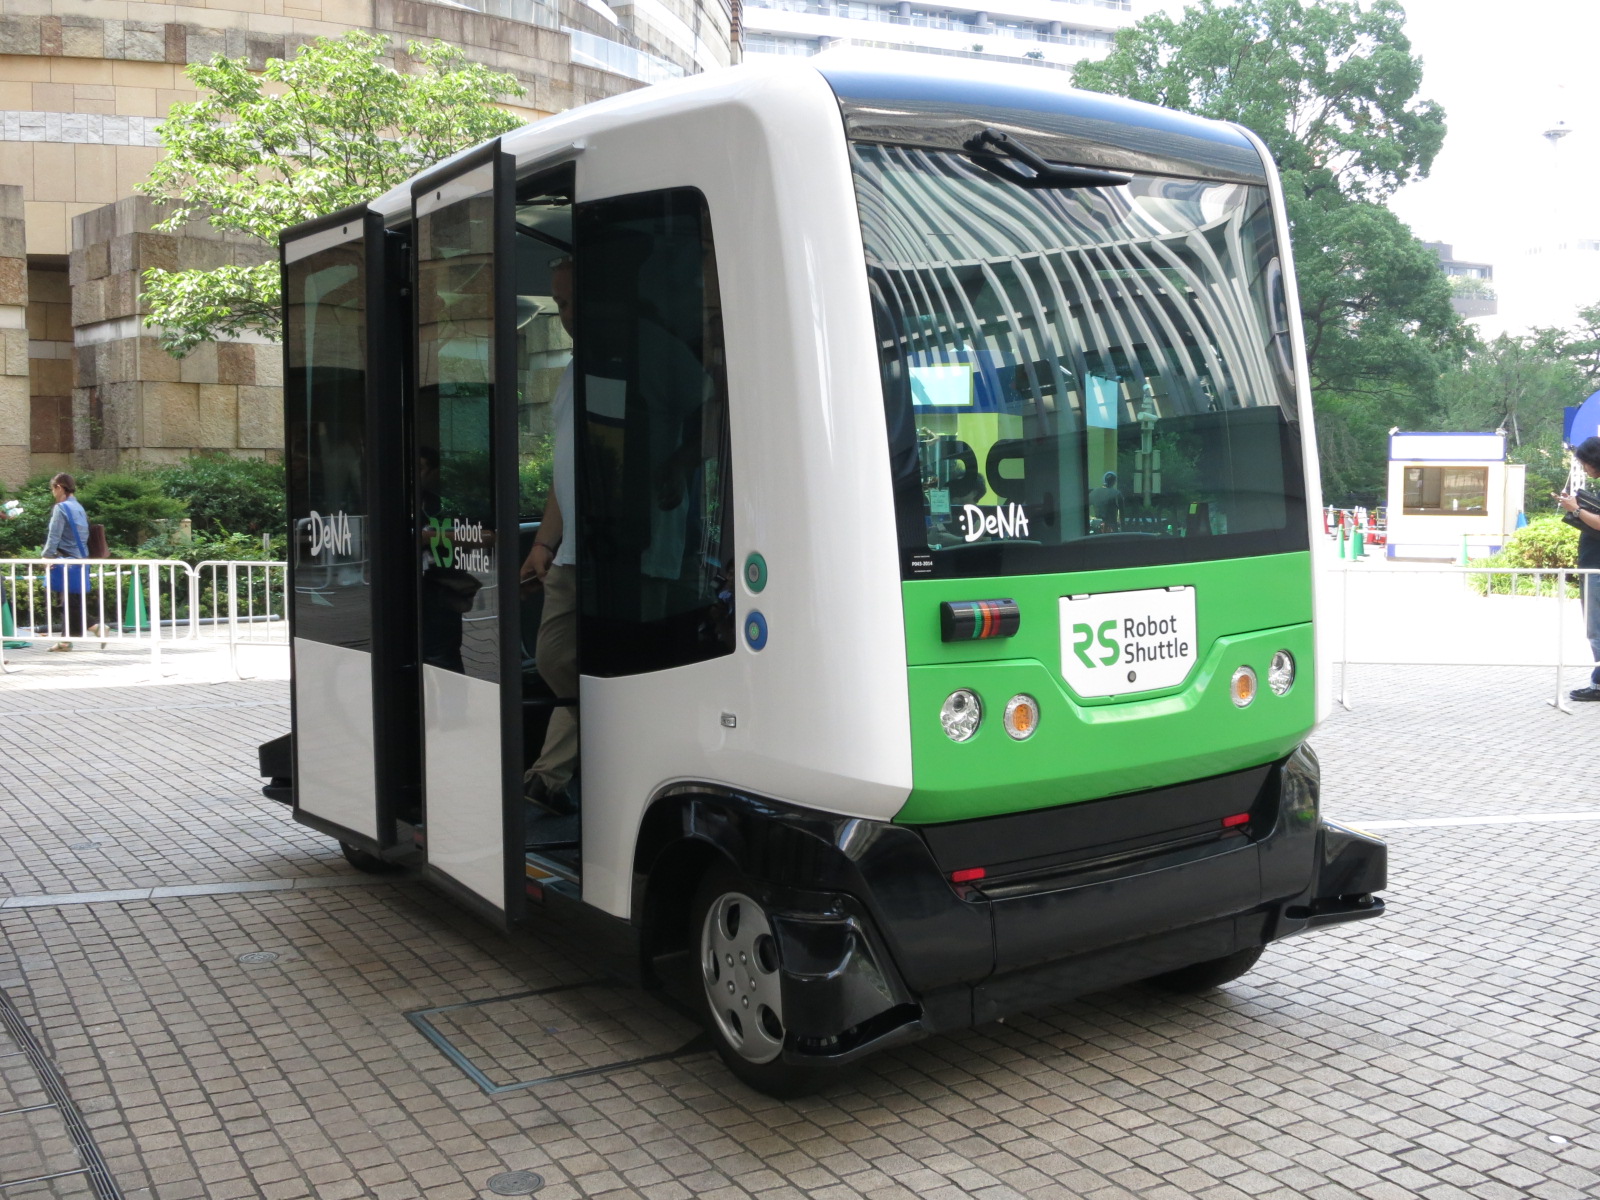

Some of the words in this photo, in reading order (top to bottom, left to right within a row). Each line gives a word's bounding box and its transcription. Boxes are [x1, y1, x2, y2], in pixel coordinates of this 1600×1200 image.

[430, 517, 453, 568] RS
[454, 518, 483, 543] Robot
[454, 547, 489, 573] Shuttle
[1124, 615, 1177, 638] Robot
[1073, 619, 1120, 669] RS
[1124, 637, 1188, 664] Shuttle
